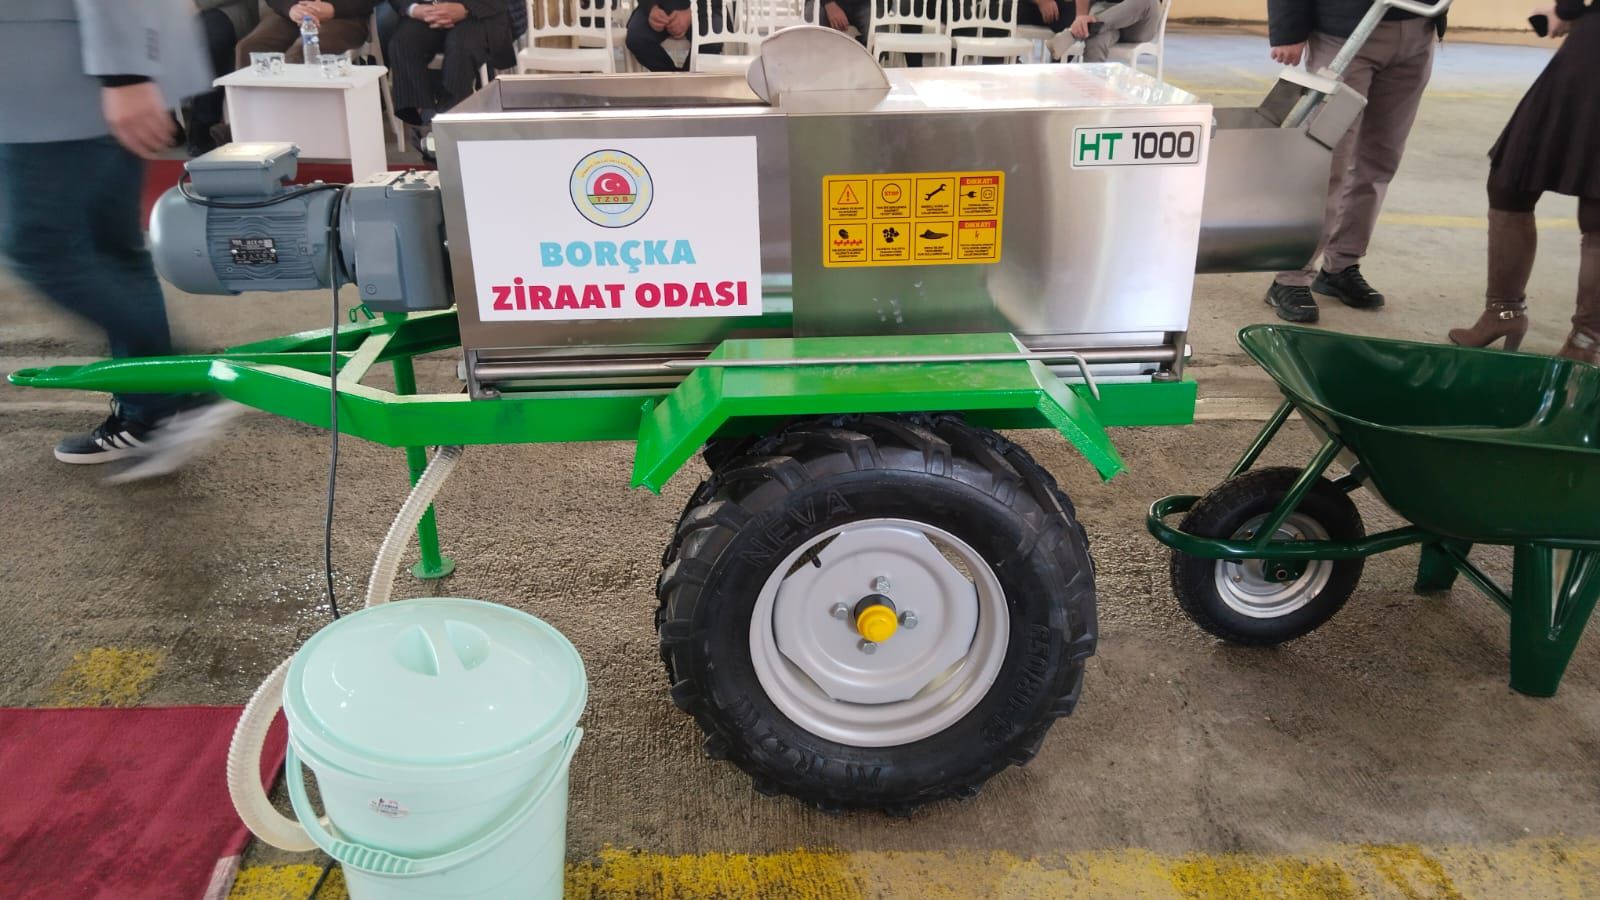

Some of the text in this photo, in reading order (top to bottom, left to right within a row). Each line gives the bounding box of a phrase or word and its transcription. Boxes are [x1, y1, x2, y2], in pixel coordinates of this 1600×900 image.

[1079, 131, 1195, 161] HT 1000
[539, 239, 697, 273] BORÇKA
[491, 276, 748, 311] ZİRAAT ODASI
[740, 488, 856, 568] NEVA
